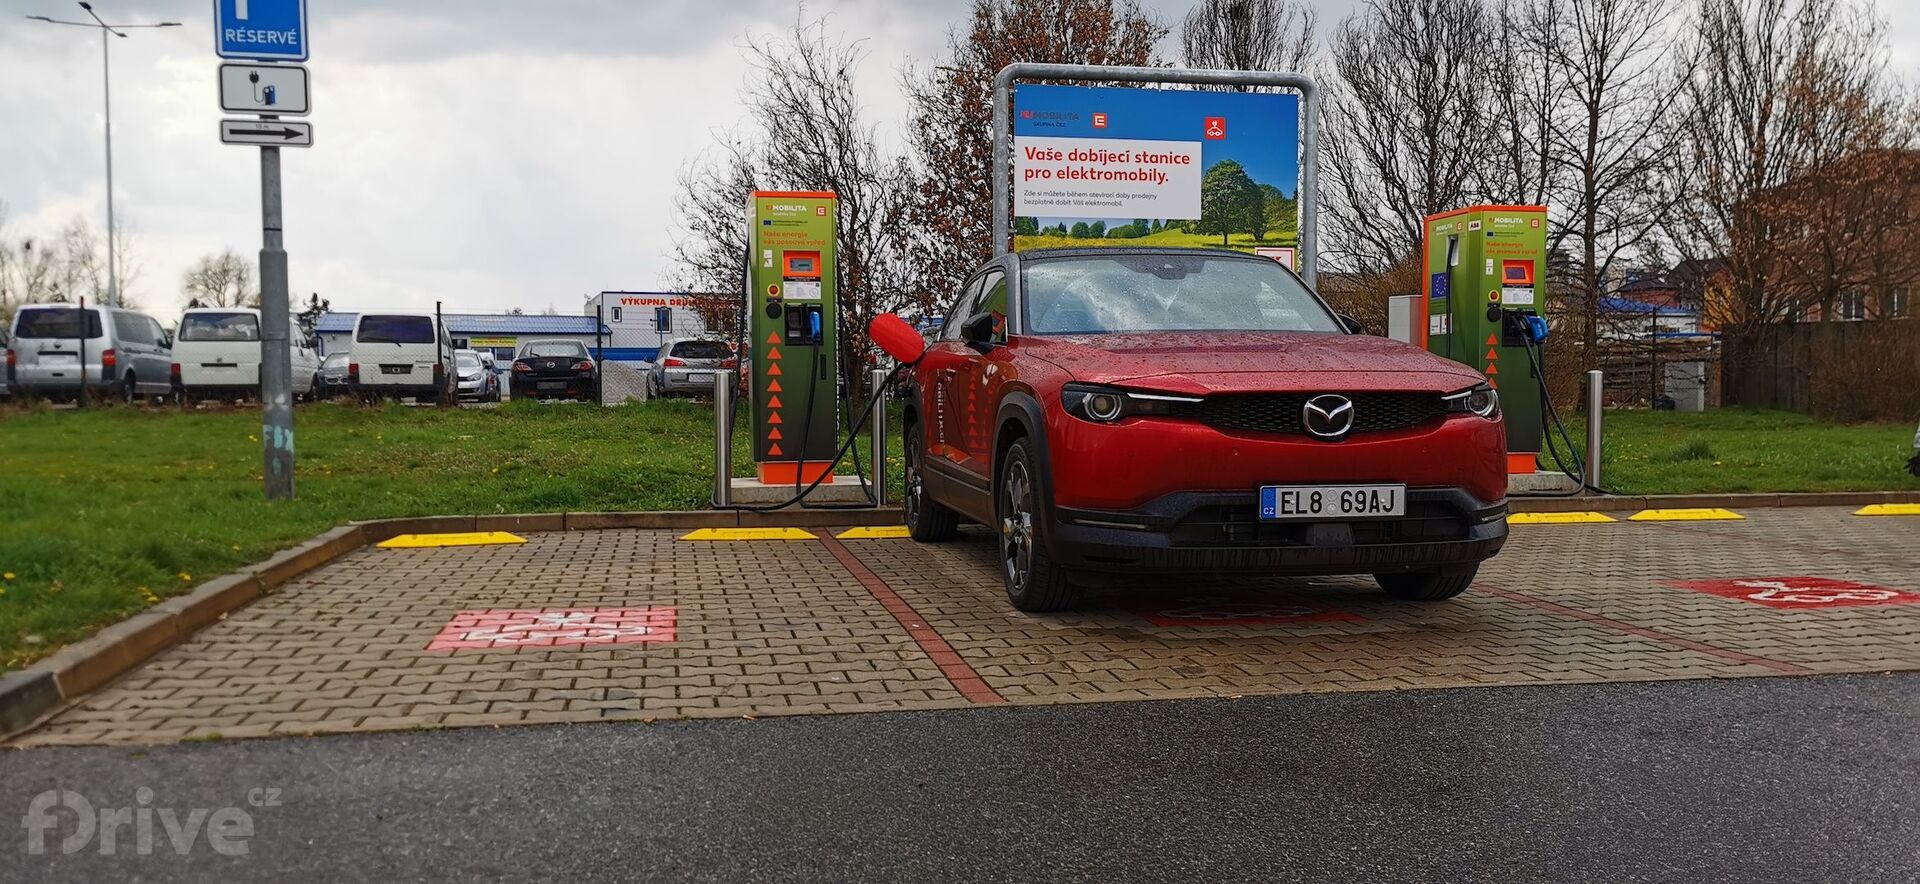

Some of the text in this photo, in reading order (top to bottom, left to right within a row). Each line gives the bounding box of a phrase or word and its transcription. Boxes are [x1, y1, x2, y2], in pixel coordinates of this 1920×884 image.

[225, 27, 297, 45] RÉSERVÉ
[1025, 146, 1190, 165] Vaše dobíjecí stanice
[1024, 166, 1169, 185] pro elektromobily.
[1043, 189, 1066, 198] můžete
[1089, 191, 1115, 199] otevírací
[1116, 192, 1130, 200] doby
[1024, 198, 1054, 206] bezplatně
[620, 297, 667, 305] VÝKUPNA
[1281, 489, 1395, 514] EL8 69AJ
[1263, 507, 1275, 515] CZ
